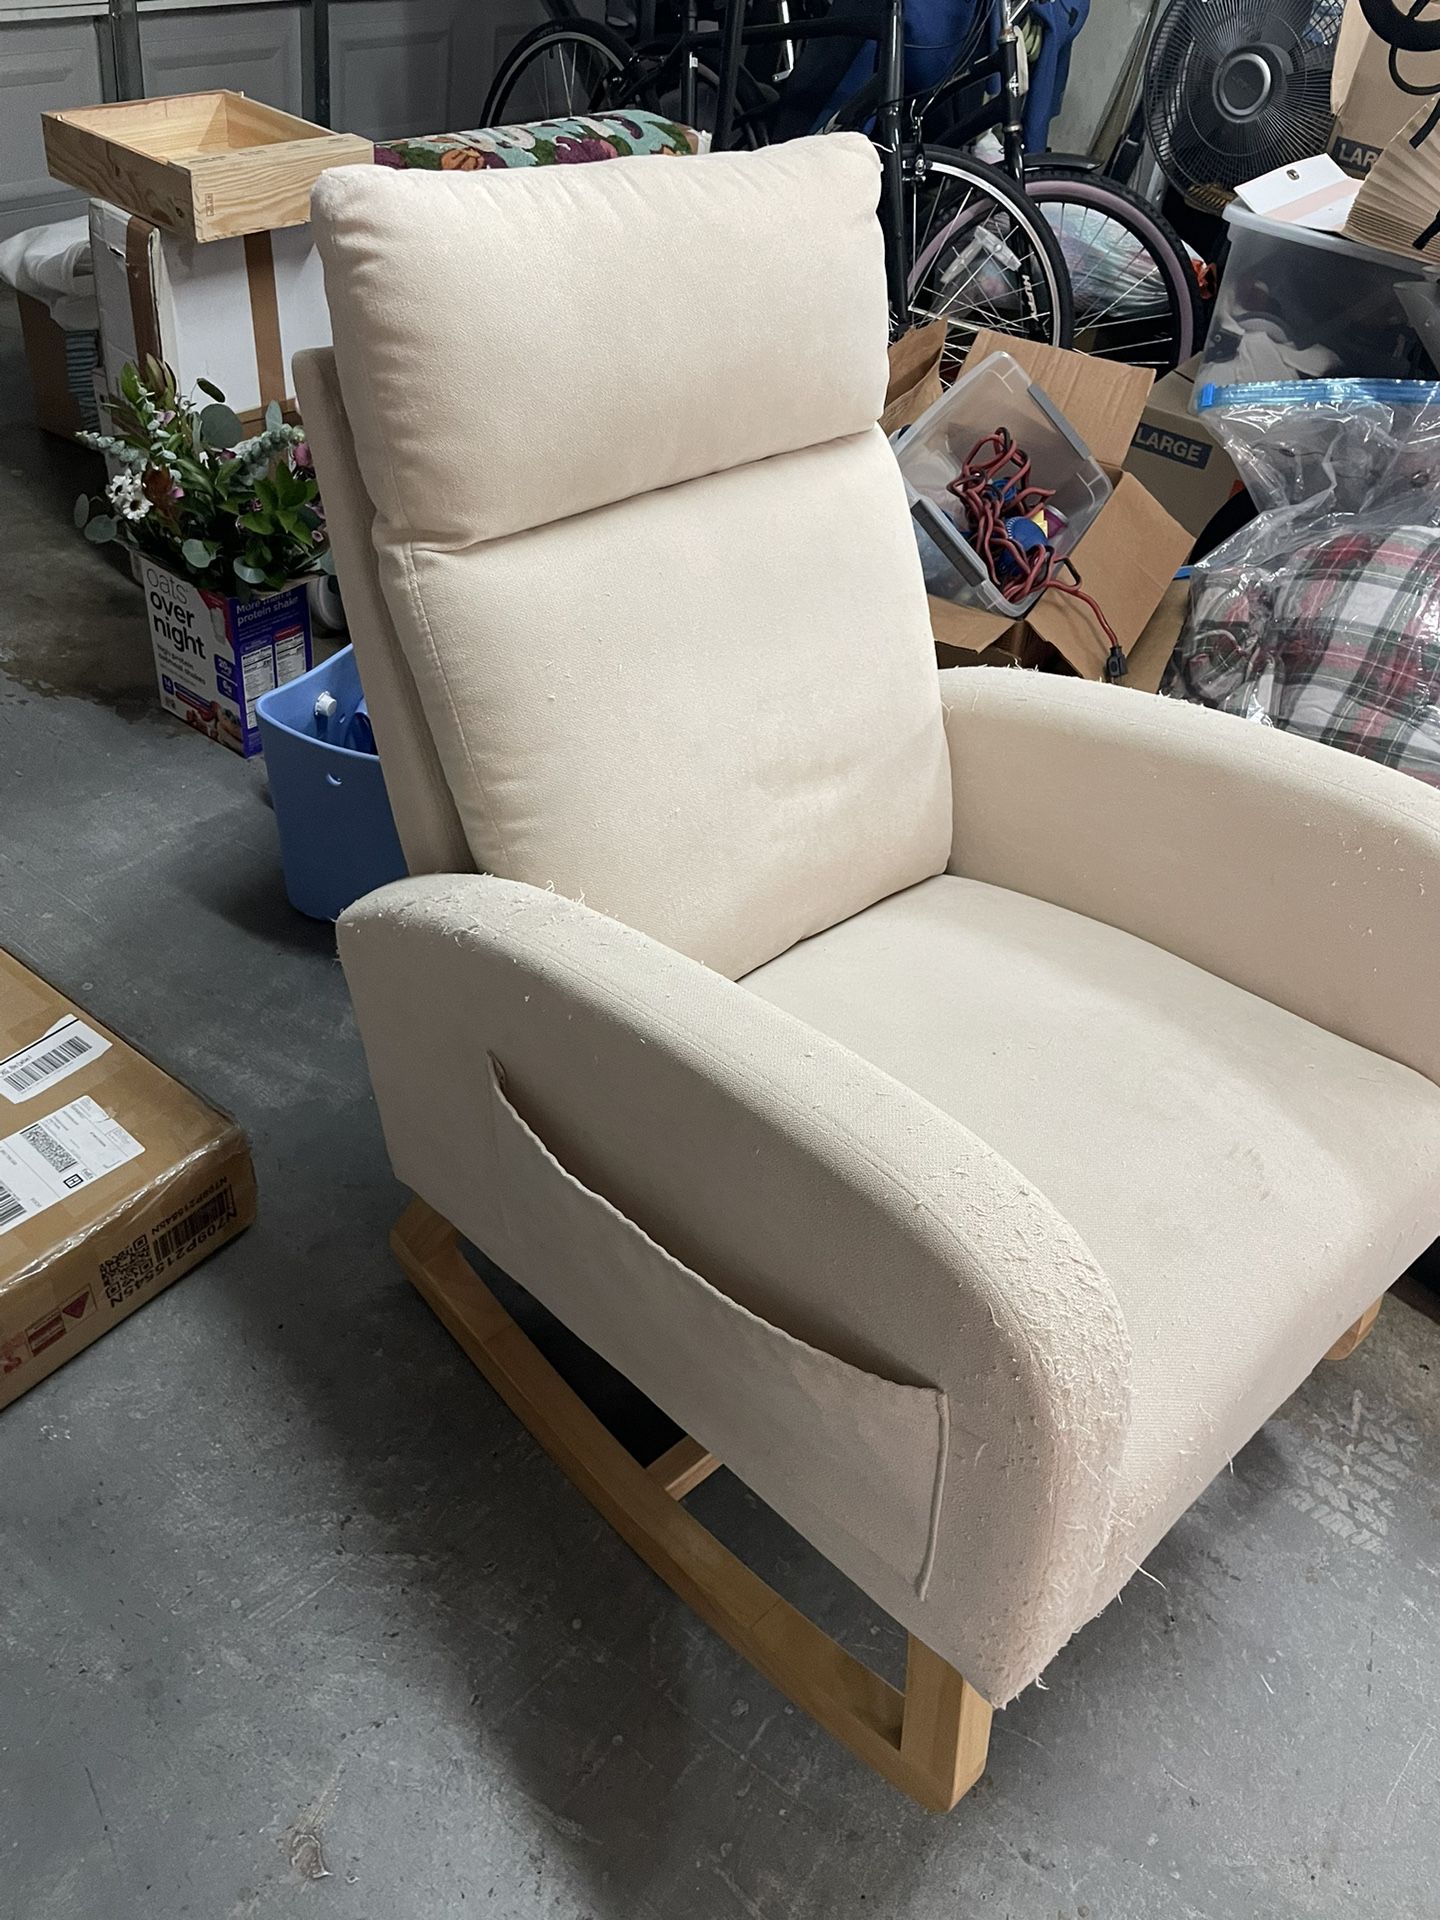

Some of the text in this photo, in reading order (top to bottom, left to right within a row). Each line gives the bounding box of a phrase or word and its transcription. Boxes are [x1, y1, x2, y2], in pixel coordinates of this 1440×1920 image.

[1338, 143, 1379, 167] LAR
[1135, 427, 1202, 462] LARGE
[146, 568, 188, 605] oats
[150, 591, 195, 628] over
[236, 600, 261, 615] More
[237, 606, 272, 627] protein
[153, 614, 207, 660] night
